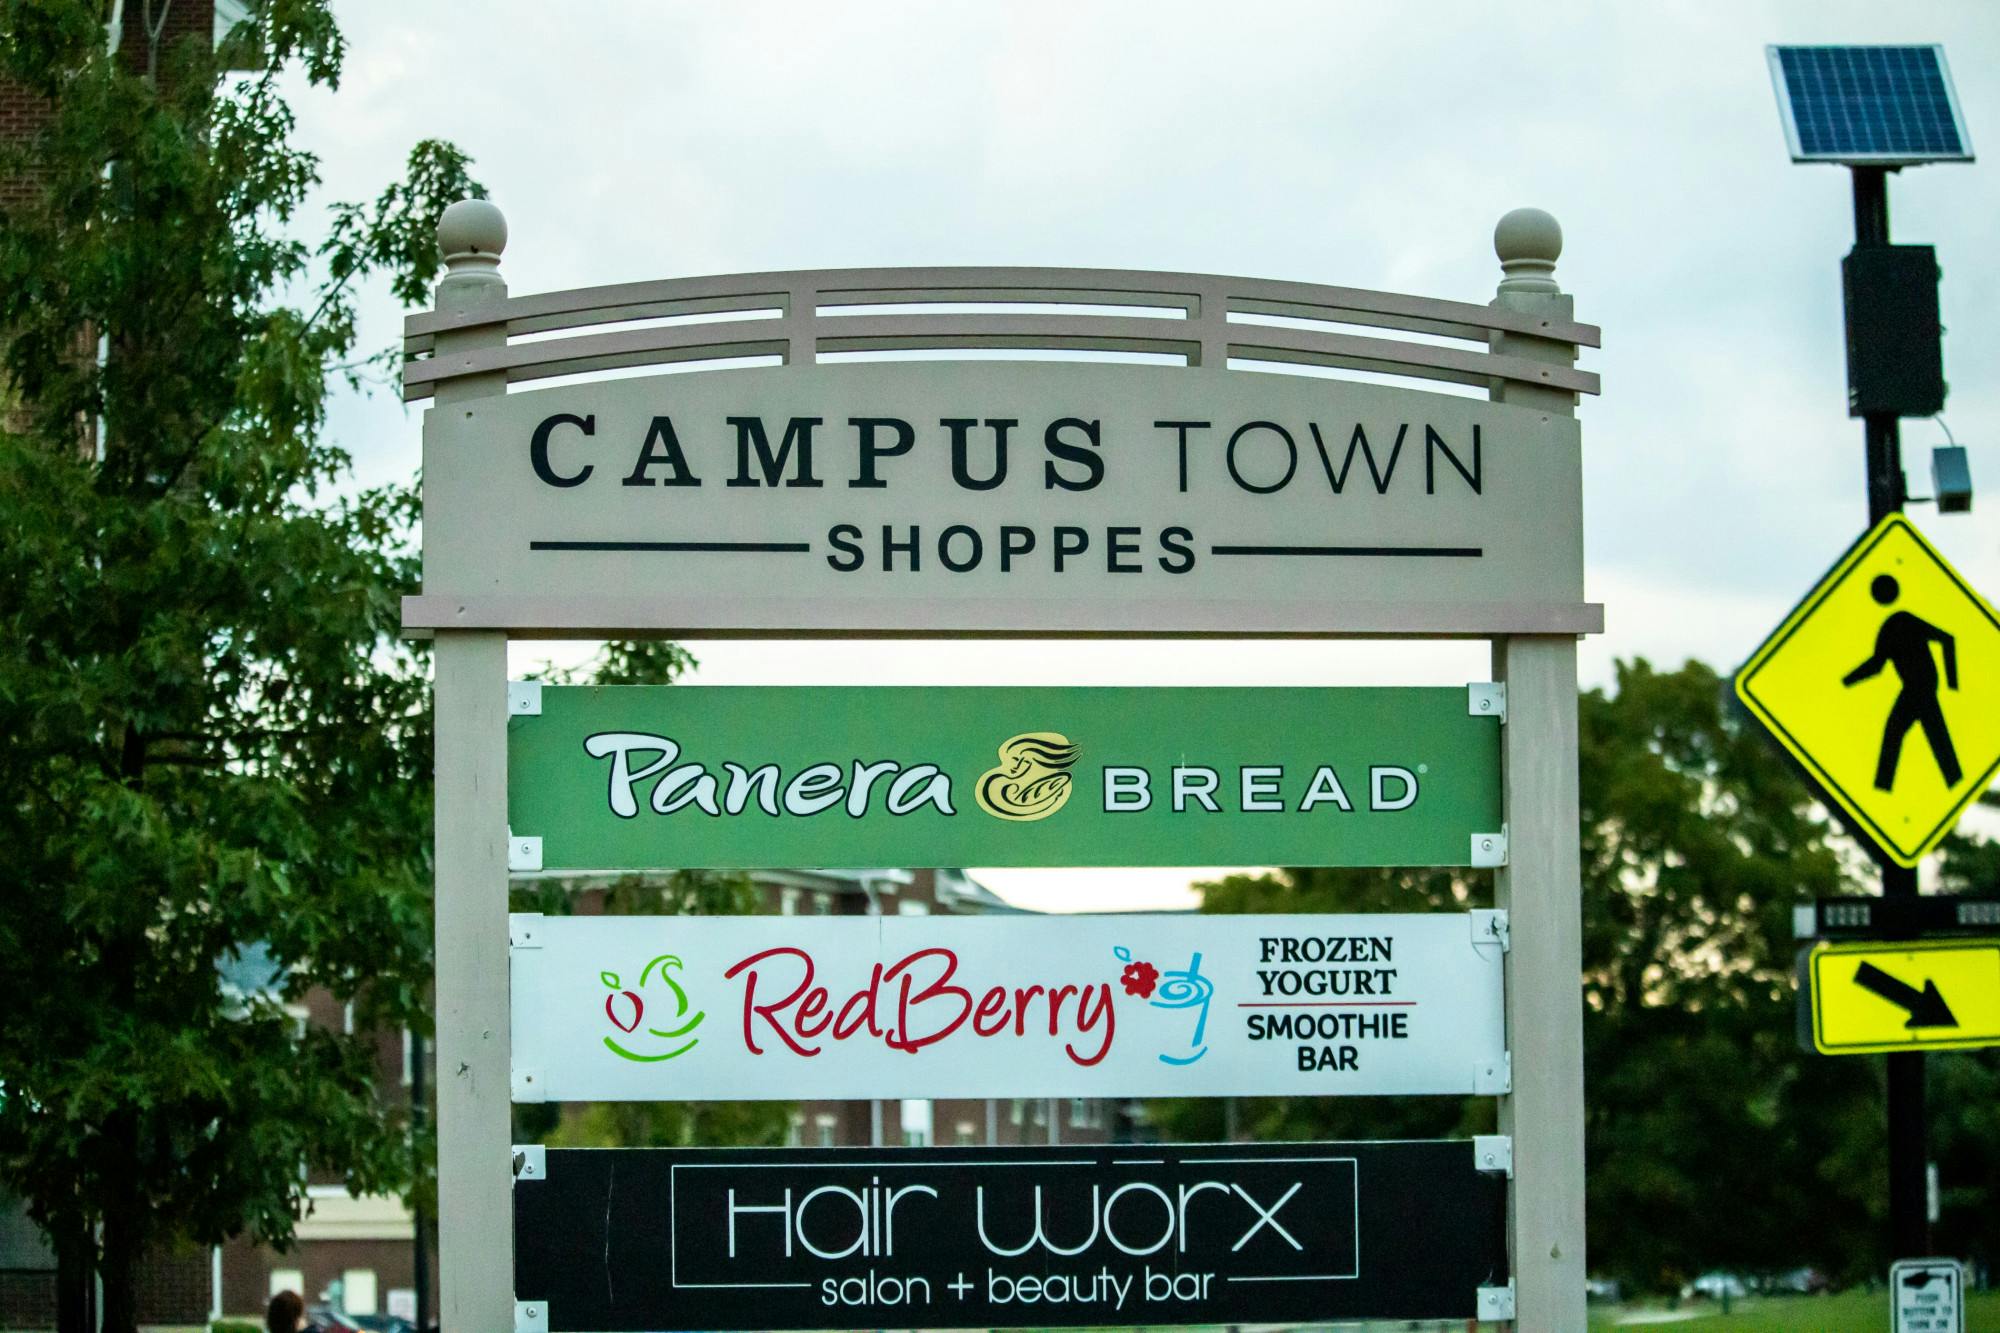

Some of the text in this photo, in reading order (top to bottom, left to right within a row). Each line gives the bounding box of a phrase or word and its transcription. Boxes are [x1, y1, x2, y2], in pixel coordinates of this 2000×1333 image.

[530, 413, 1482, 496] CAMPUS TOWN
[826, 523, 1196, 575] SHOPPES
[584, 731, 1420, 819] Panera BREAD
[1259, 936, 1393, 963] FROZEN
[725, 946, 1116, 1067] RedBerry
[1256, 968, 1398, 996] YOGURT
[1246, 1012, 1409, 1041] SMOOTHIE
[1297, 1045, 1359, 1072] BAR
[728, 1176, 938, 1259] Hair
[821, 1265, 1215, 1311] salon + beauty bar
